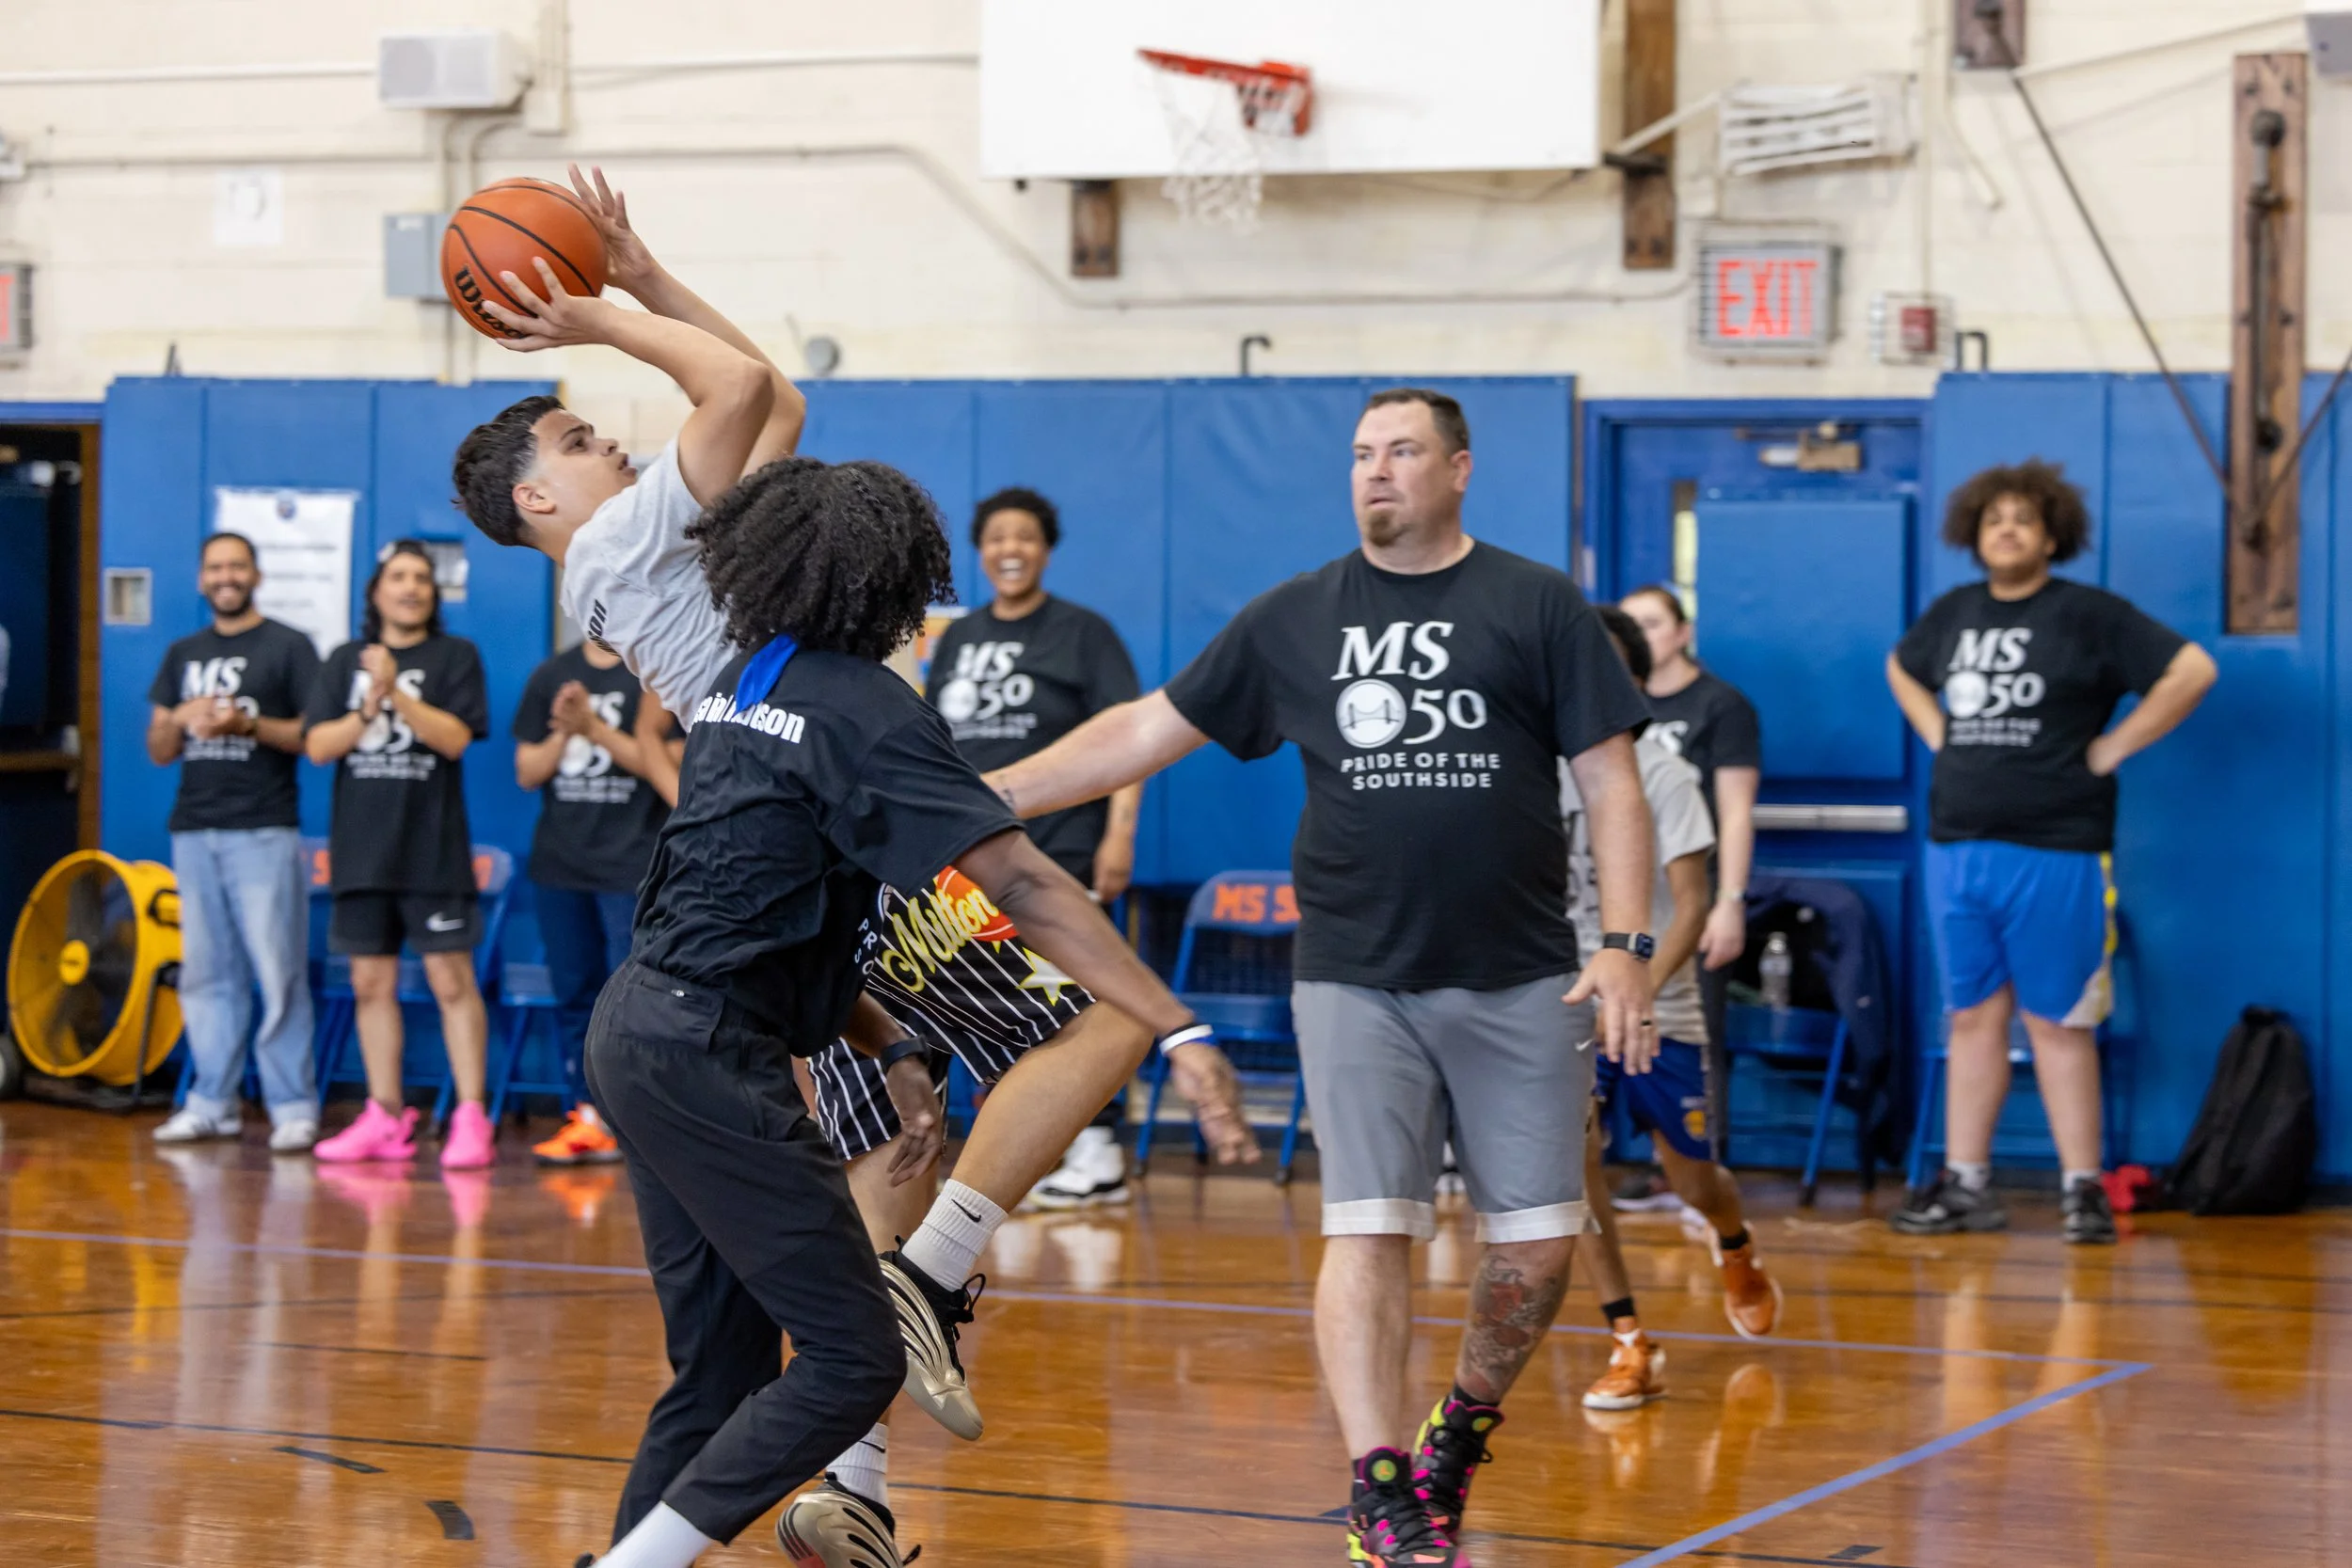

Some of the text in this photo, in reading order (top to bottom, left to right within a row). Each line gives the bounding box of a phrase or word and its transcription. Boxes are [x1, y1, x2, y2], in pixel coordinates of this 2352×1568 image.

[1717, 260, 1819, 337] EXIT
[948, 641, 1025, 683] MS
[1330, 621, 1455, 681] MS
[1947, 627, 2033, 673] MS
[180, 657, 247, 701] MS
[976, 673, 1034, 721] 50
[1978, 672, 2046, 718] 50
[1403, 689, 1488, 744] 50
[1340, 752, 1501, 773] PRIDE OF THE
[1352, 772, 1492, 791] SOUTHSIDE
[1212, 882, 1266, 923] MS
[882, 888, 999, 992] Milton
